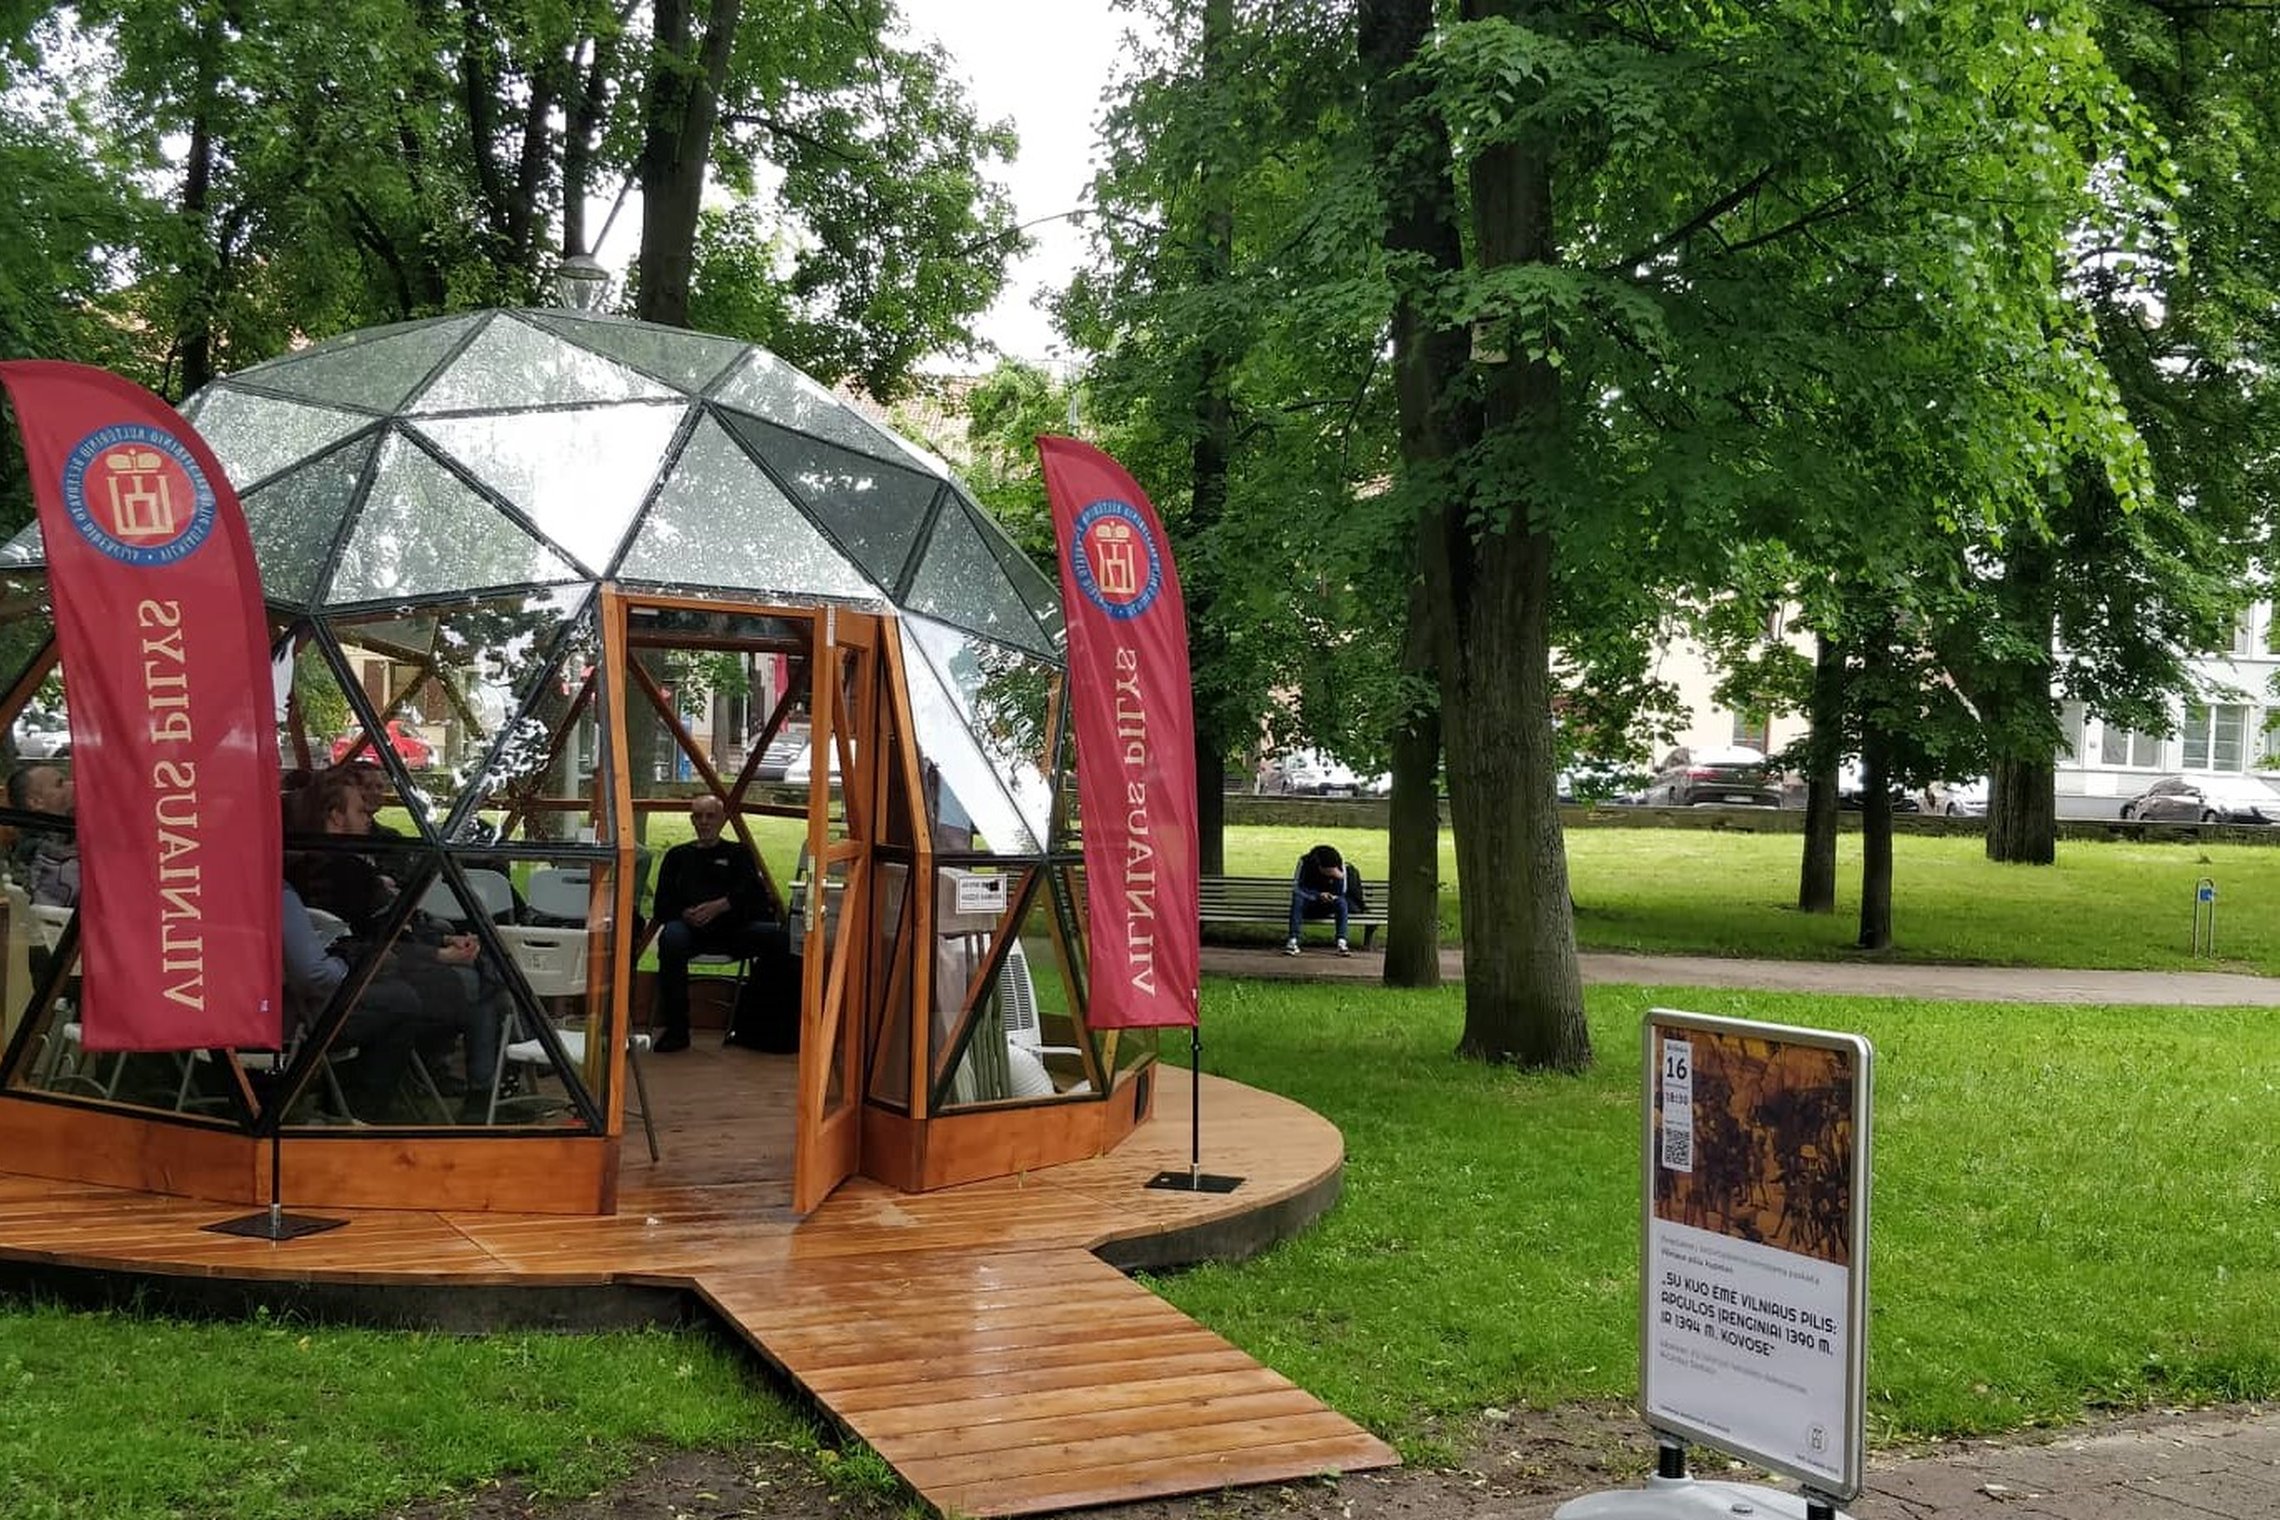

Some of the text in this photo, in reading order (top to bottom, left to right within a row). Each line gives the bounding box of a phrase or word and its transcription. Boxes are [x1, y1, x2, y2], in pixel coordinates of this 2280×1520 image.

[1667, 1056, 1687, 1080] 16
[1685, 1278, 1710, 1297] KUO
[1741, 1293, 1798, 1322] VILNIAUS
[1675, 1314, 1700, 1333] 1394
[1786, 1327, 1815, 1348] 1390
